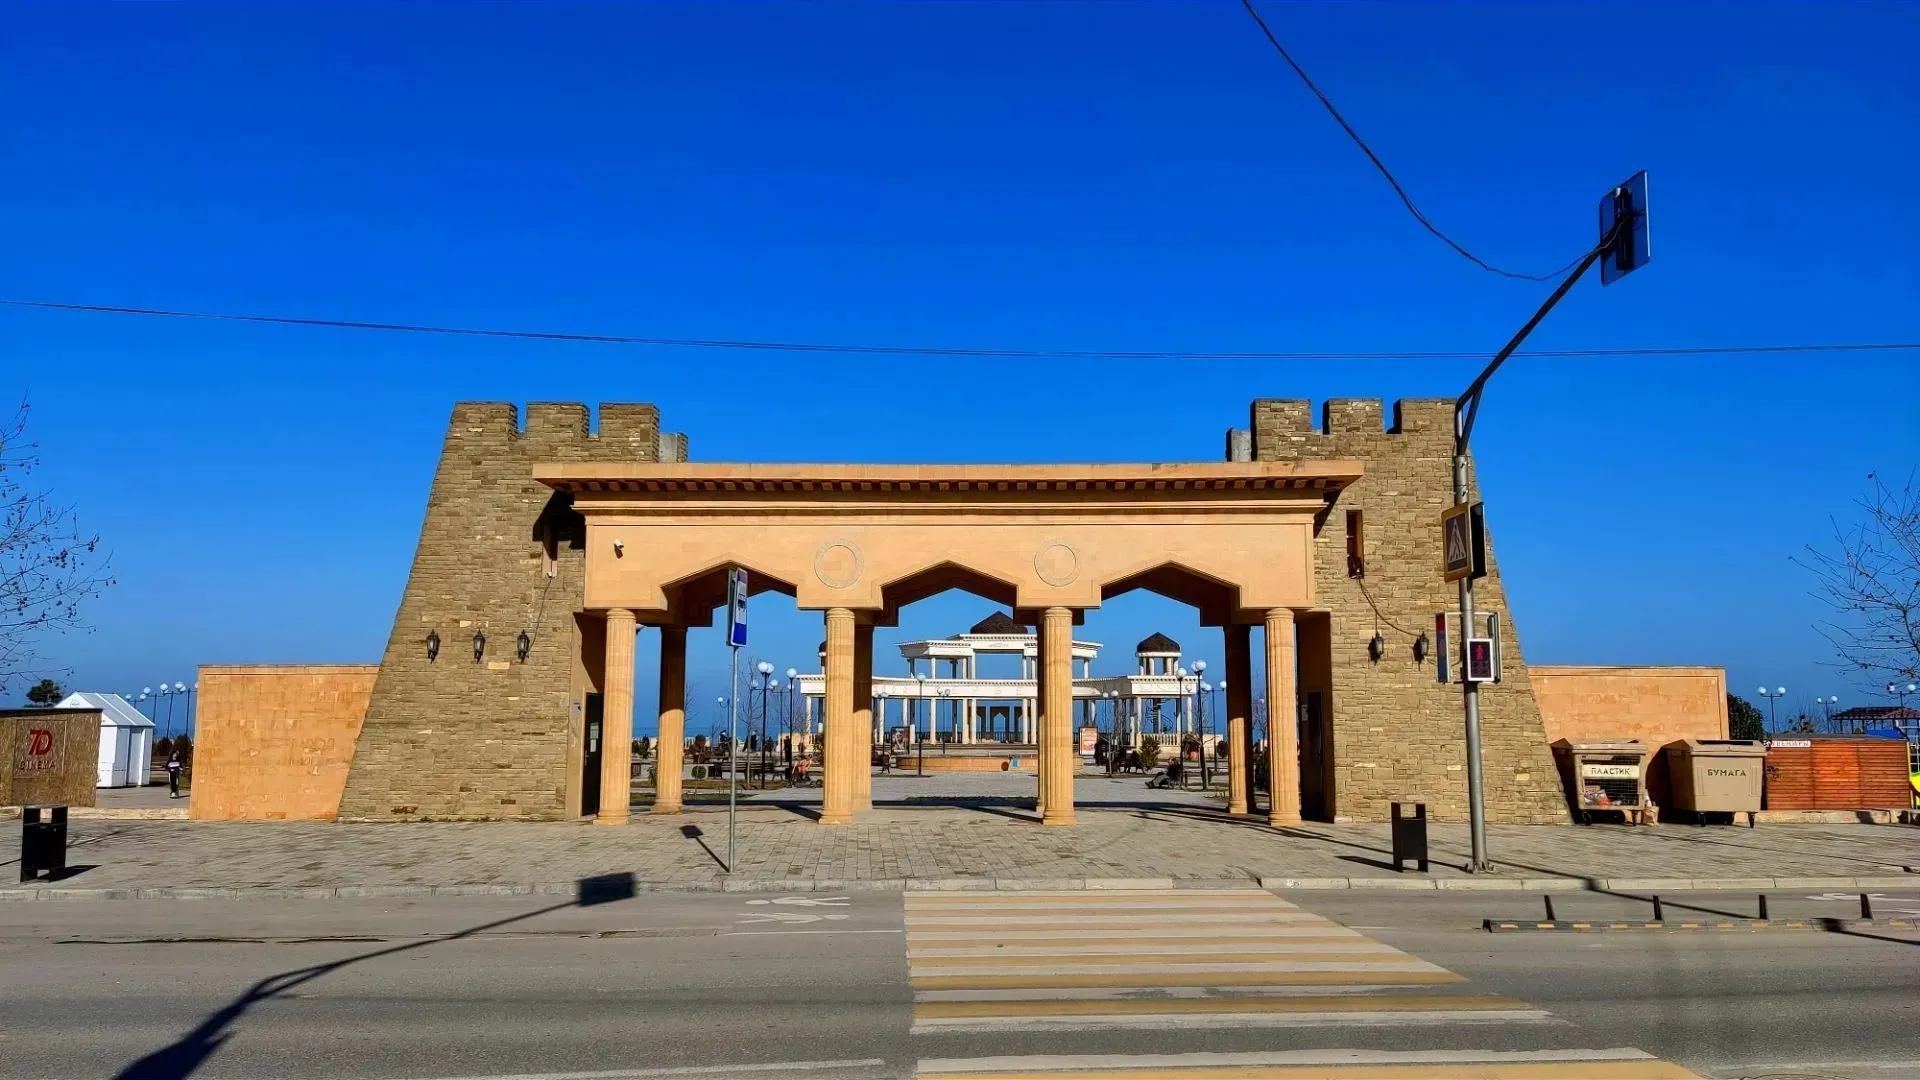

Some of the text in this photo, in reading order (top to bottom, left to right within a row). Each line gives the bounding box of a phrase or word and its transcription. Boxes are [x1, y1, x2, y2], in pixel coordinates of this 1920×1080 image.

[29, 730, 53, 755] 7D
[21, 761, 56, 769] CINEMA
[1591, 767, 1630, 775] ПЛАСТИК
